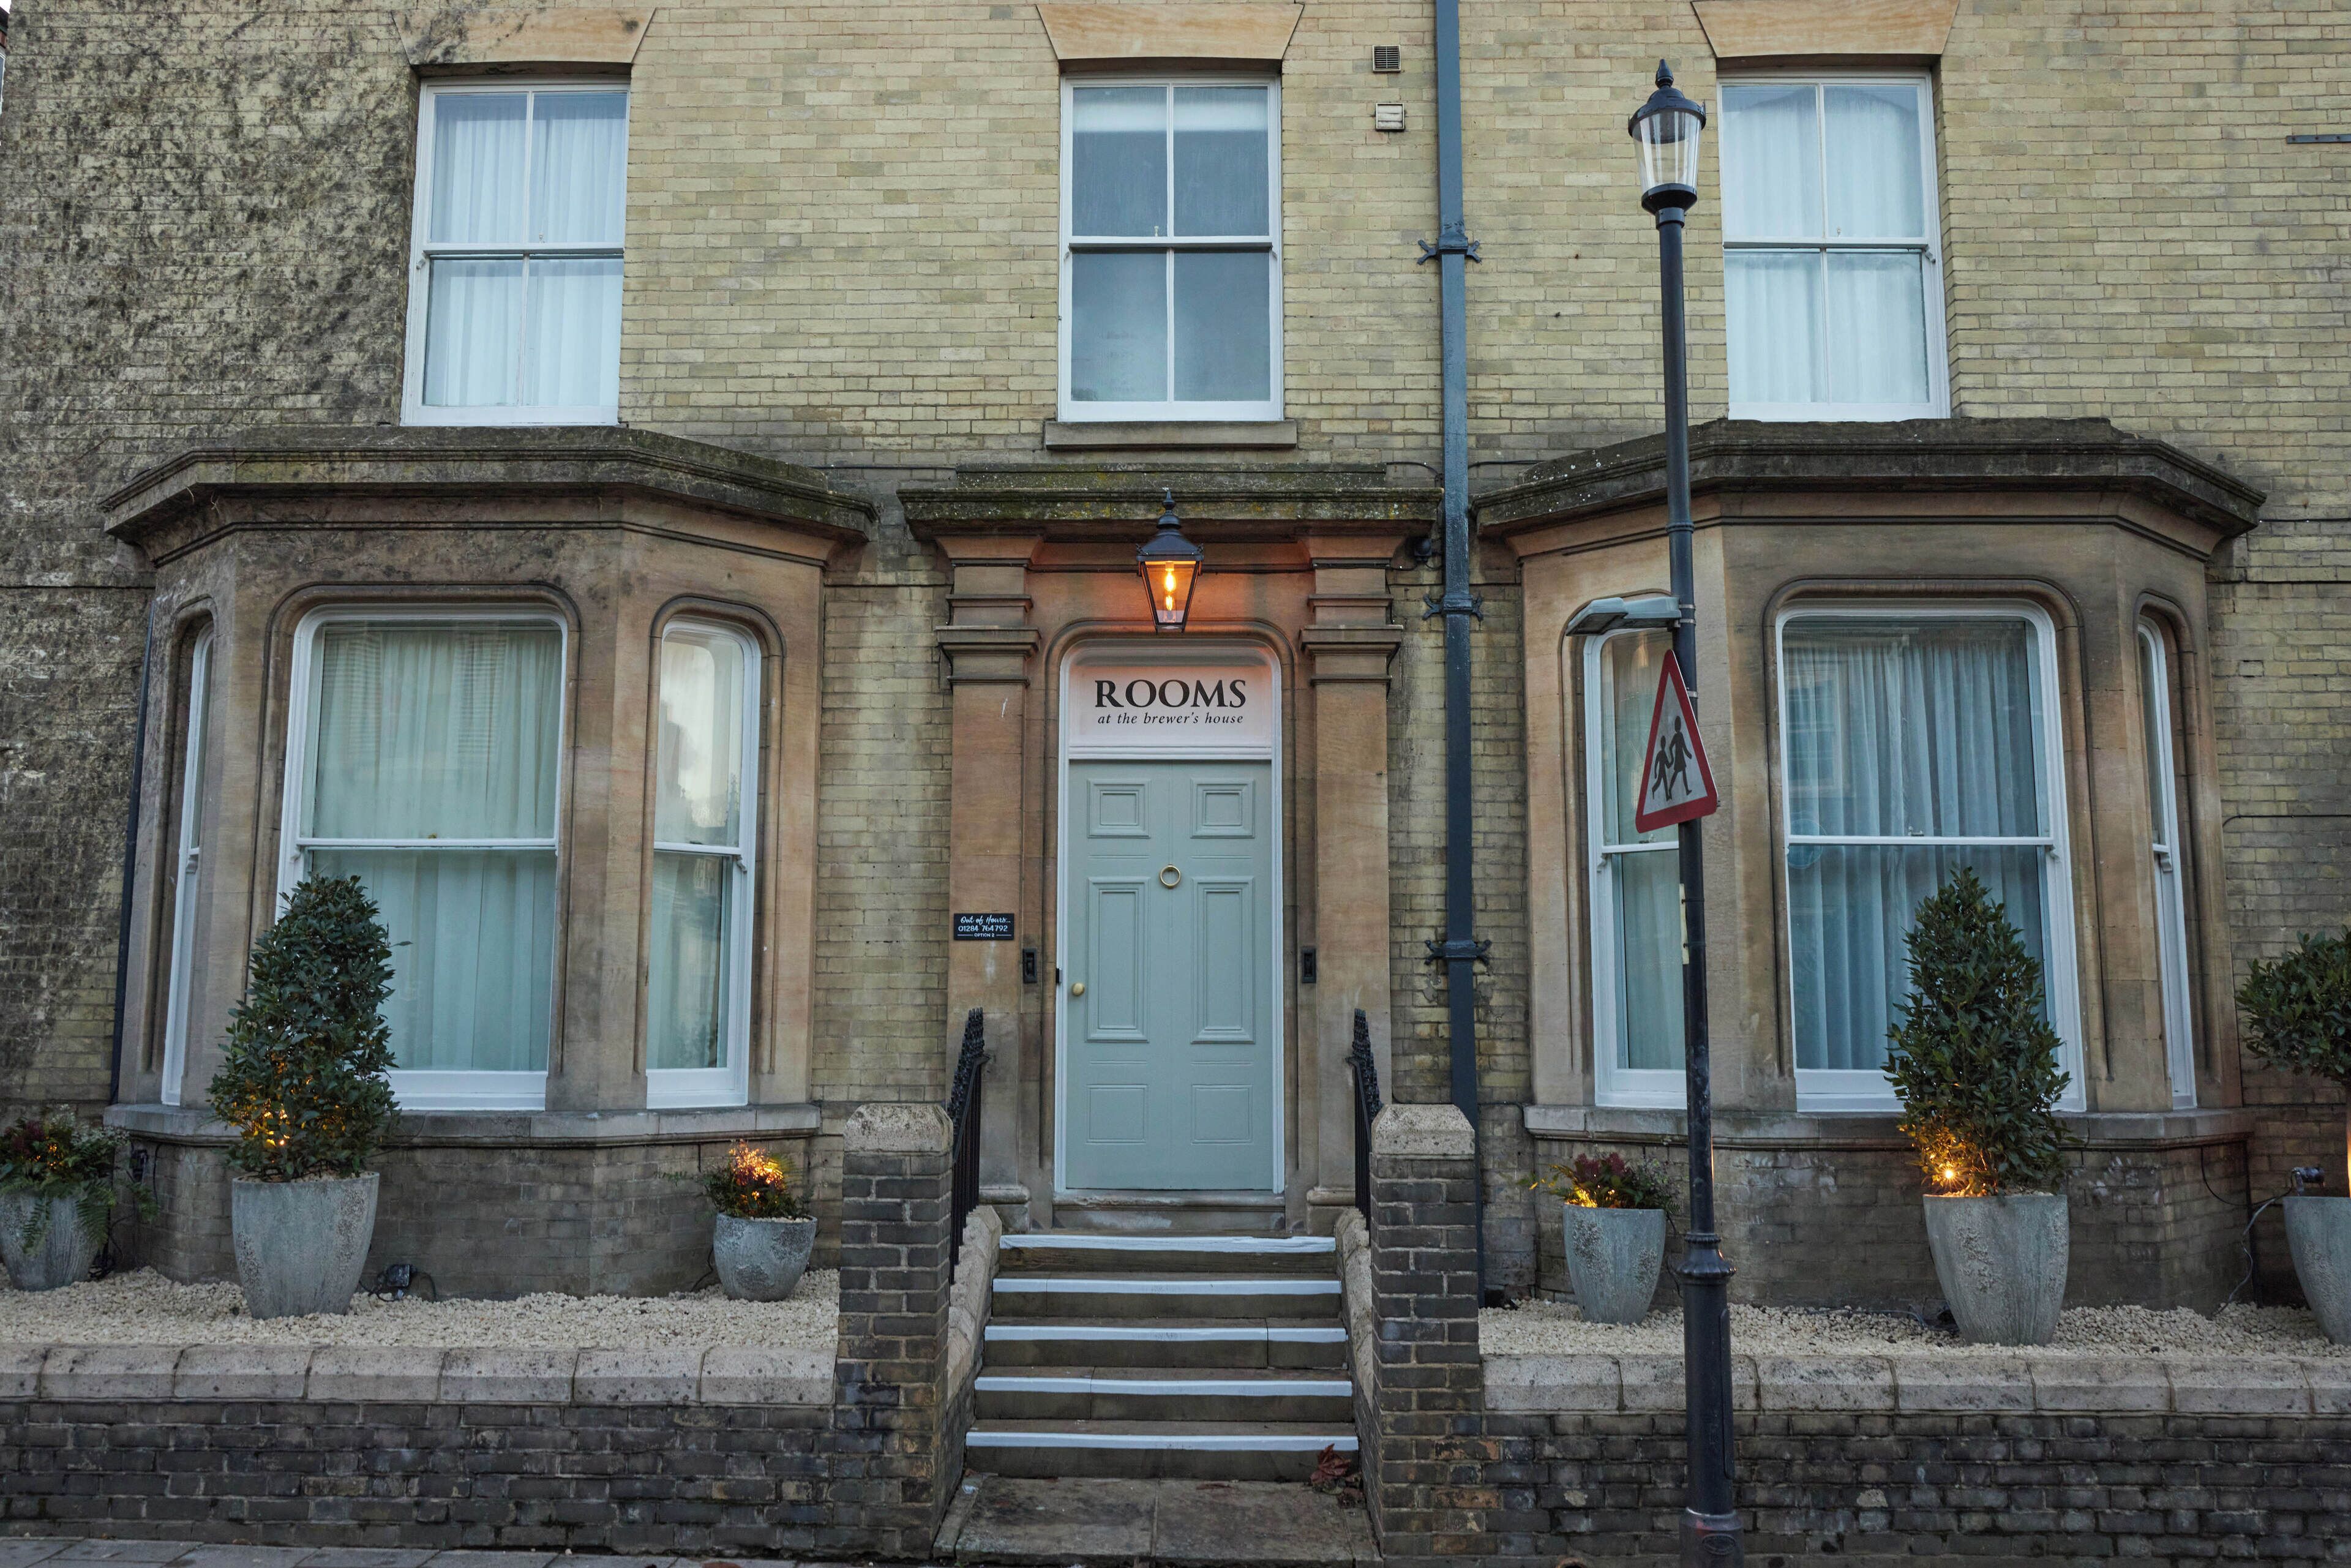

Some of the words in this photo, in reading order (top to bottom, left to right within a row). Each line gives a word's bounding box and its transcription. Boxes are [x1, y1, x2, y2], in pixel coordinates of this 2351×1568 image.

[1095, 679, 1247, 708] ROOMS
[1097, 714, 1111, 724] at
[1117, 712, 1137, 724] the
[1144, 712, 1198, 724] brewer's
[1205, 712, 1243, 724] house
[975, 915, 983, 925] of
